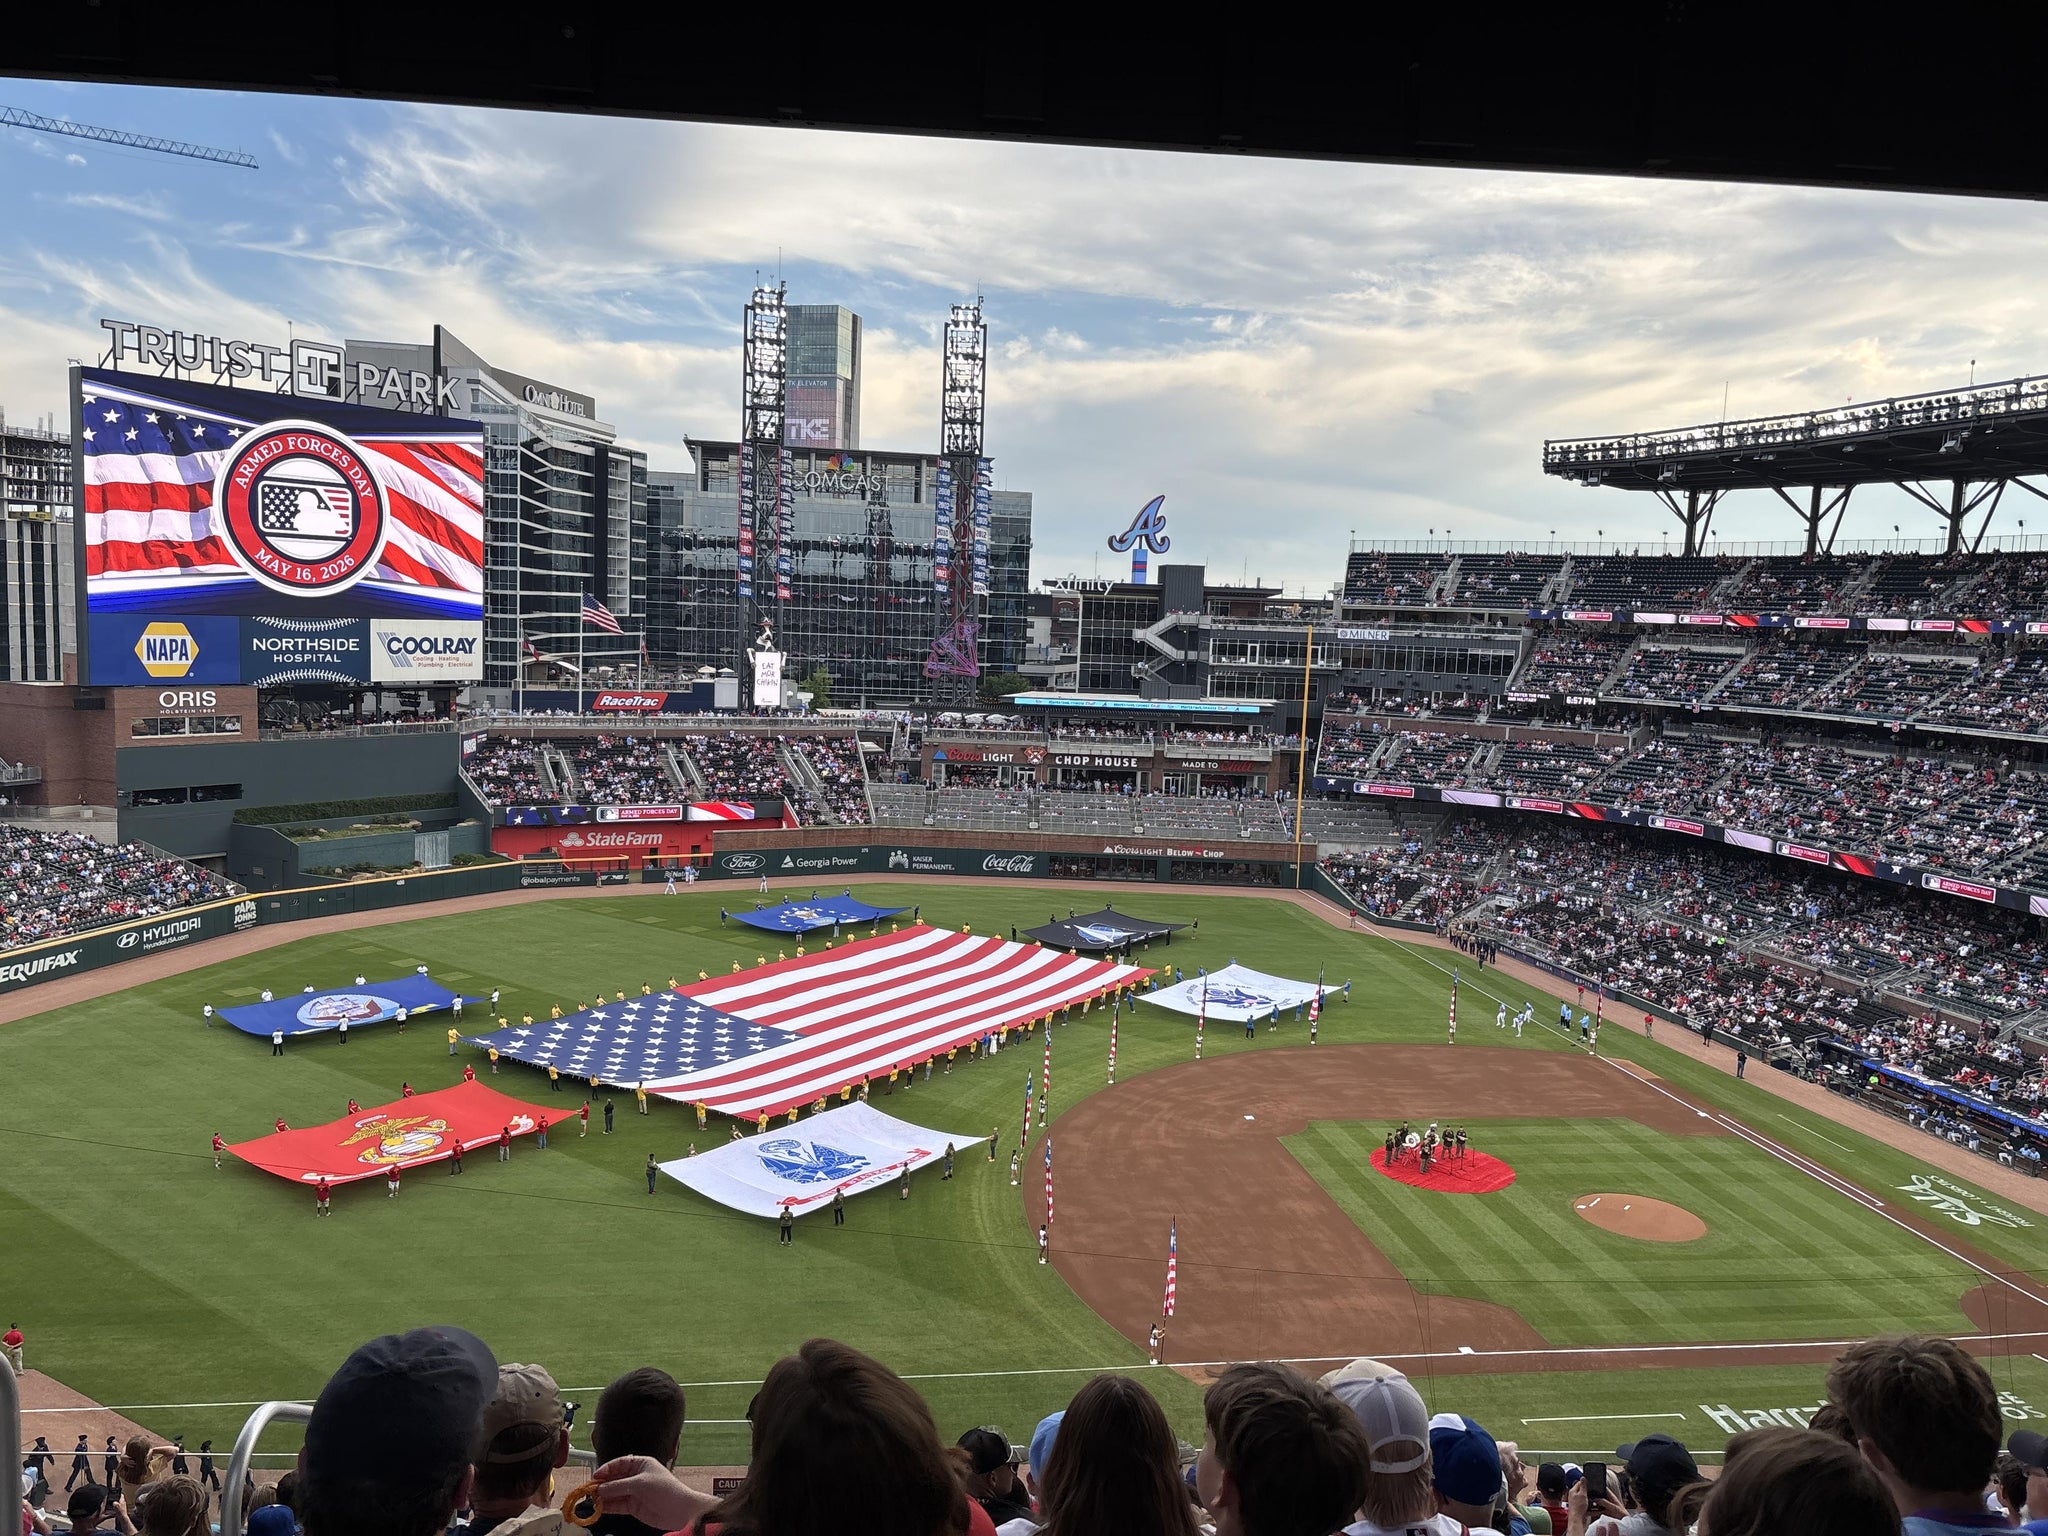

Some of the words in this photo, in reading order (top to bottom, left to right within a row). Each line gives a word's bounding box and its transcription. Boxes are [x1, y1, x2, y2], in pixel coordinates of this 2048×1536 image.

[101, 319, 281, 382] TRUIST
[357, 362, 460, 408] PARK
[560, 394, 586, 417] HOTEL
[233, 440, 285, 489] ARMED
[287, 436, 351, 469] FORCES
[347, 467, 374, 499] DAY
[793, 470, 889, 491] COMCAST
[255, 548, 291, 579] MAY
[295, 566, 316, 582] 16,
[321, 554, 356, 580] 2026
[1055, 573, 1114, 595] xfinity
[1350, 630, 1388, 640] MILNER
[146, 638, 189, 661] NAPA
[252, 638, 359, 652] NORTHSIDE
[386, 637, 477, 654] COOLRAY
[274, 654, 341, 663] HOSPITAL
[762, 662, 774, 670] EAT
[761, 670, 776, 678] MOR
[159, 691, 216, 708] ORIS
[600, 695, 659, 706] RaceTrac
[1566, 696, 1582, 704] 6:57
[1583, 697, 1596, 706] PM
[947, 748, 981, 761] Coors
[983, 753, 1014, 762] LIGHT
[1056, 754, 1089, 766] CHOP
[1095, 756, 1138, 768] HOUSE
[1182, 760, 1204, 769] MADE
[1206, 762, 1219, 770] TO
[1114, 844, 1140, 856] Coors
[1140, 848, 1163, 856] LIGHT
[1167, 848, 1194, 857] BELOW
[1203, 848, 1224, 858] CHOP
[729, 856, 758, 869] Ford
[796, 858, 830, 868] Georgia
[832, 856, 858, 866] Power
[983, 853, 1036, 874] Coca-Cola
[1981, 888, 1992, 896] DAY
[234, 901, 256, 916] PAPA
[234, 911, 257, 924] JOHNS
[143, 917, 201, 940] HYUNDAI
[143, 934, 189, 950] HyundaiUSA.com
[0, 950, 79, 983] EQUIFAX
[718, 1480, 742, 1488] CAUT
